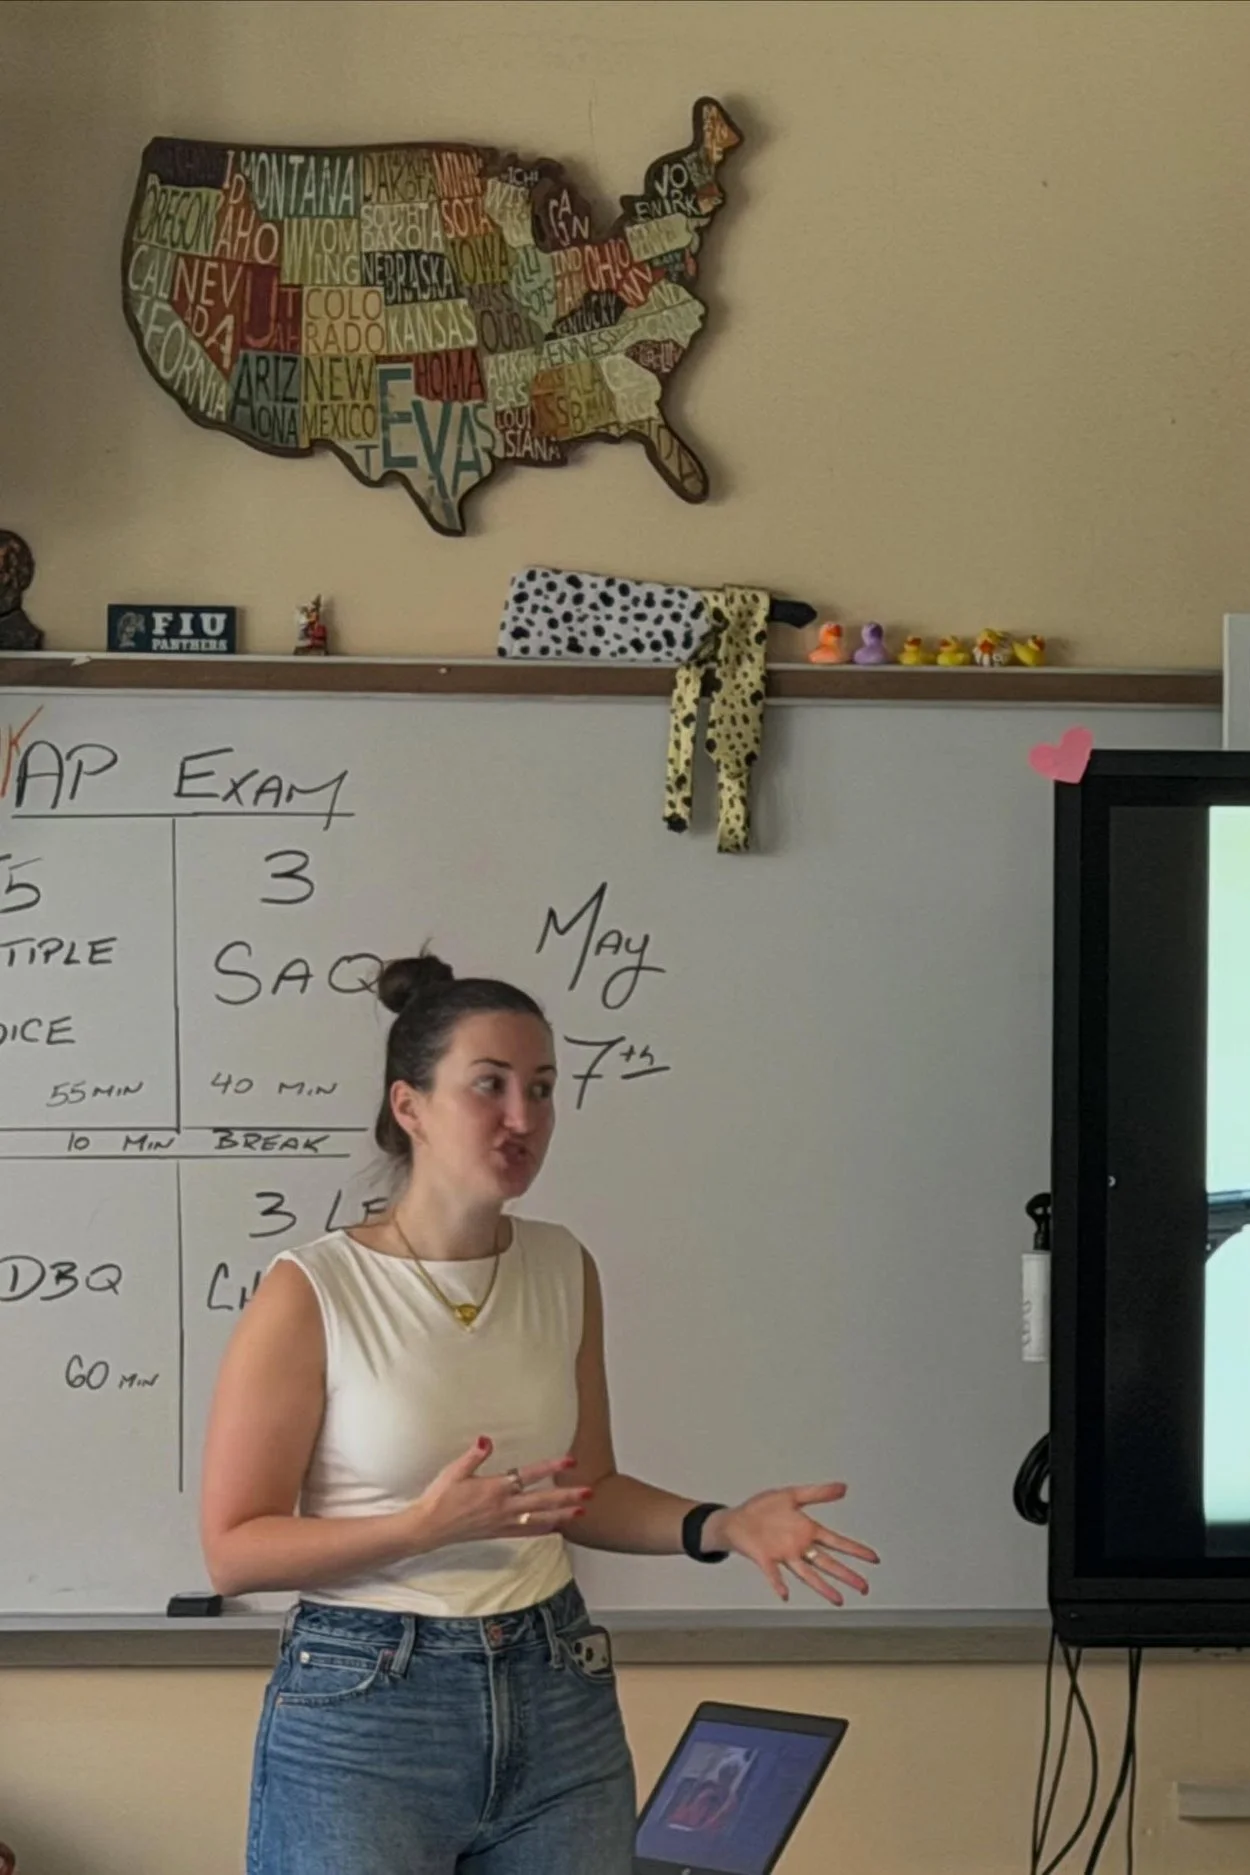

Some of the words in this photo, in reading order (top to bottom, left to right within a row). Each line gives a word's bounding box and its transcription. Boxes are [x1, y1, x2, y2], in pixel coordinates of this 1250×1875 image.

[387, 298, 478, 354] KANSAS
[303, 355, 376, 402] NEW
[302, 402, 378, 440] MEXICO
[151, 611, 227, 637] FIU
[16, 740, 119, 809] AP
[260, 849, 315, 905] 3
[214, 940, 385, 1006] SAQ
[210, 1071, 254, 1096] 40
[67, 1132, 91, 1151] 10
[213, 1128, 330, 1153] BREAK
[249, 1191, 297, 1238] 3
[0, 1254, 123, 1301] DBQ
[65, 1354, 110, 1390] 60
